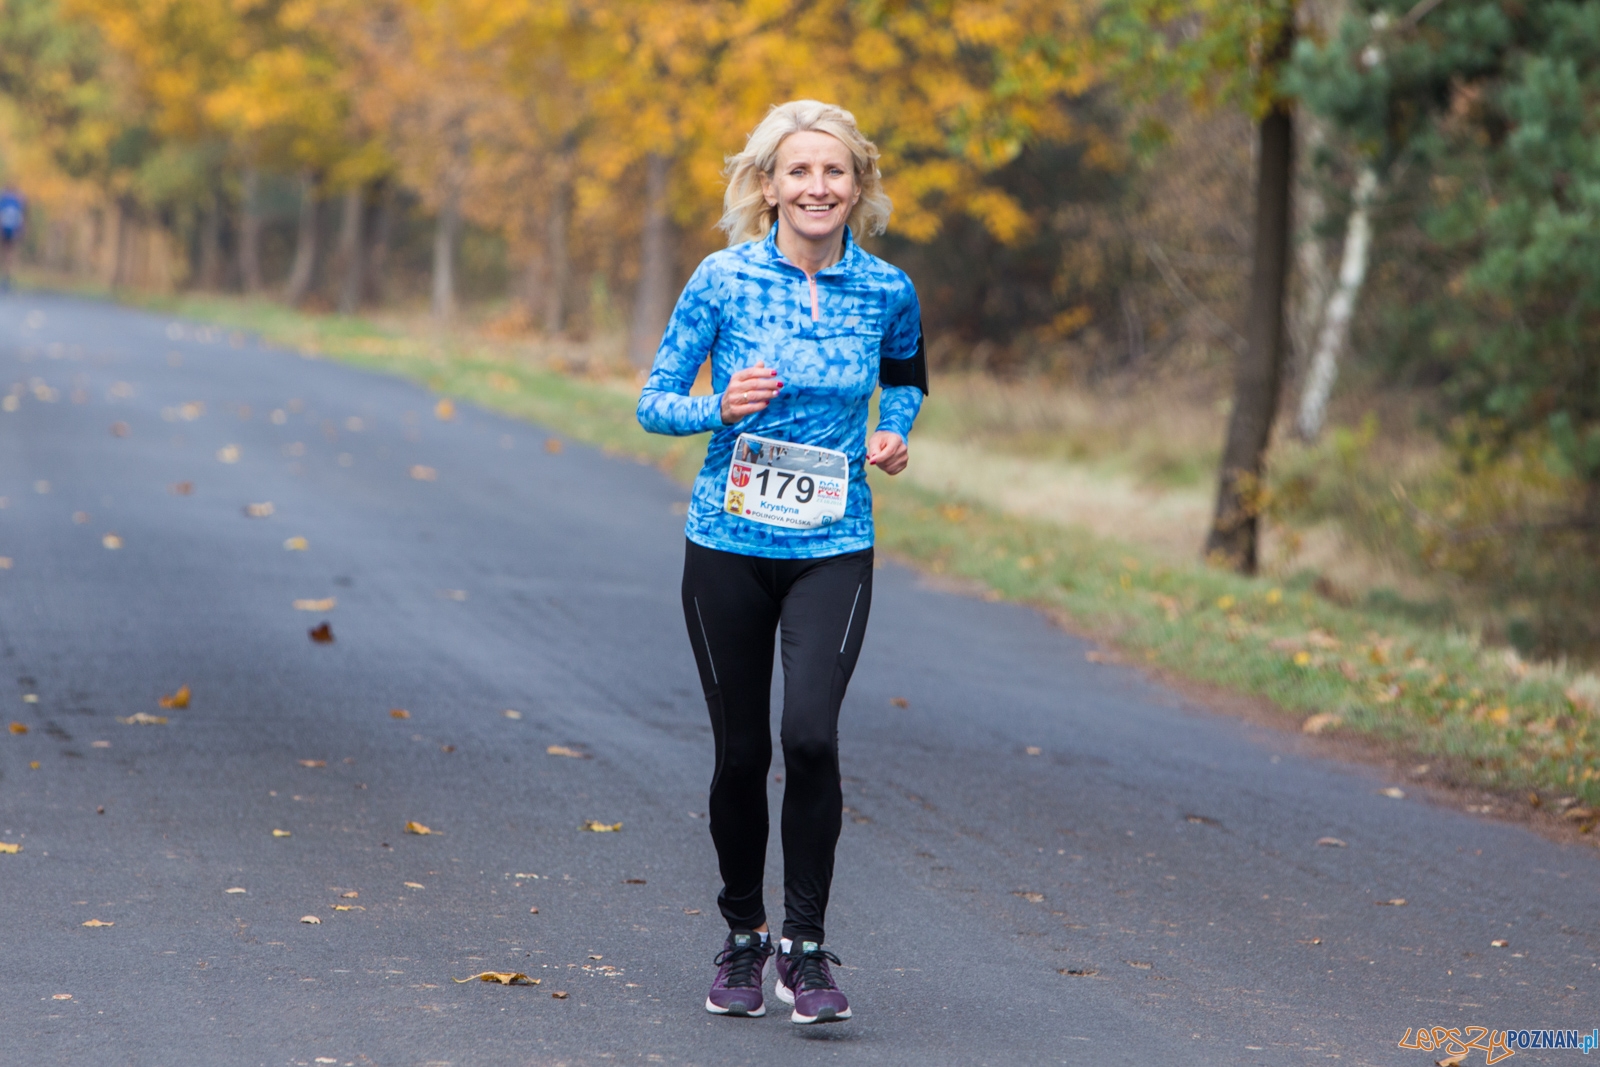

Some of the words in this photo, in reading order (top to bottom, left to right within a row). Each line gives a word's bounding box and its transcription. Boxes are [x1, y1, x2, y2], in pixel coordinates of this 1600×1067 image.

[756, 468, 815, 504] 179
[760, 500, 800, 515] Krystyna
[751, 510, 784, 522] POLINOVA
[785, 517, 812, 526] POLSKA
